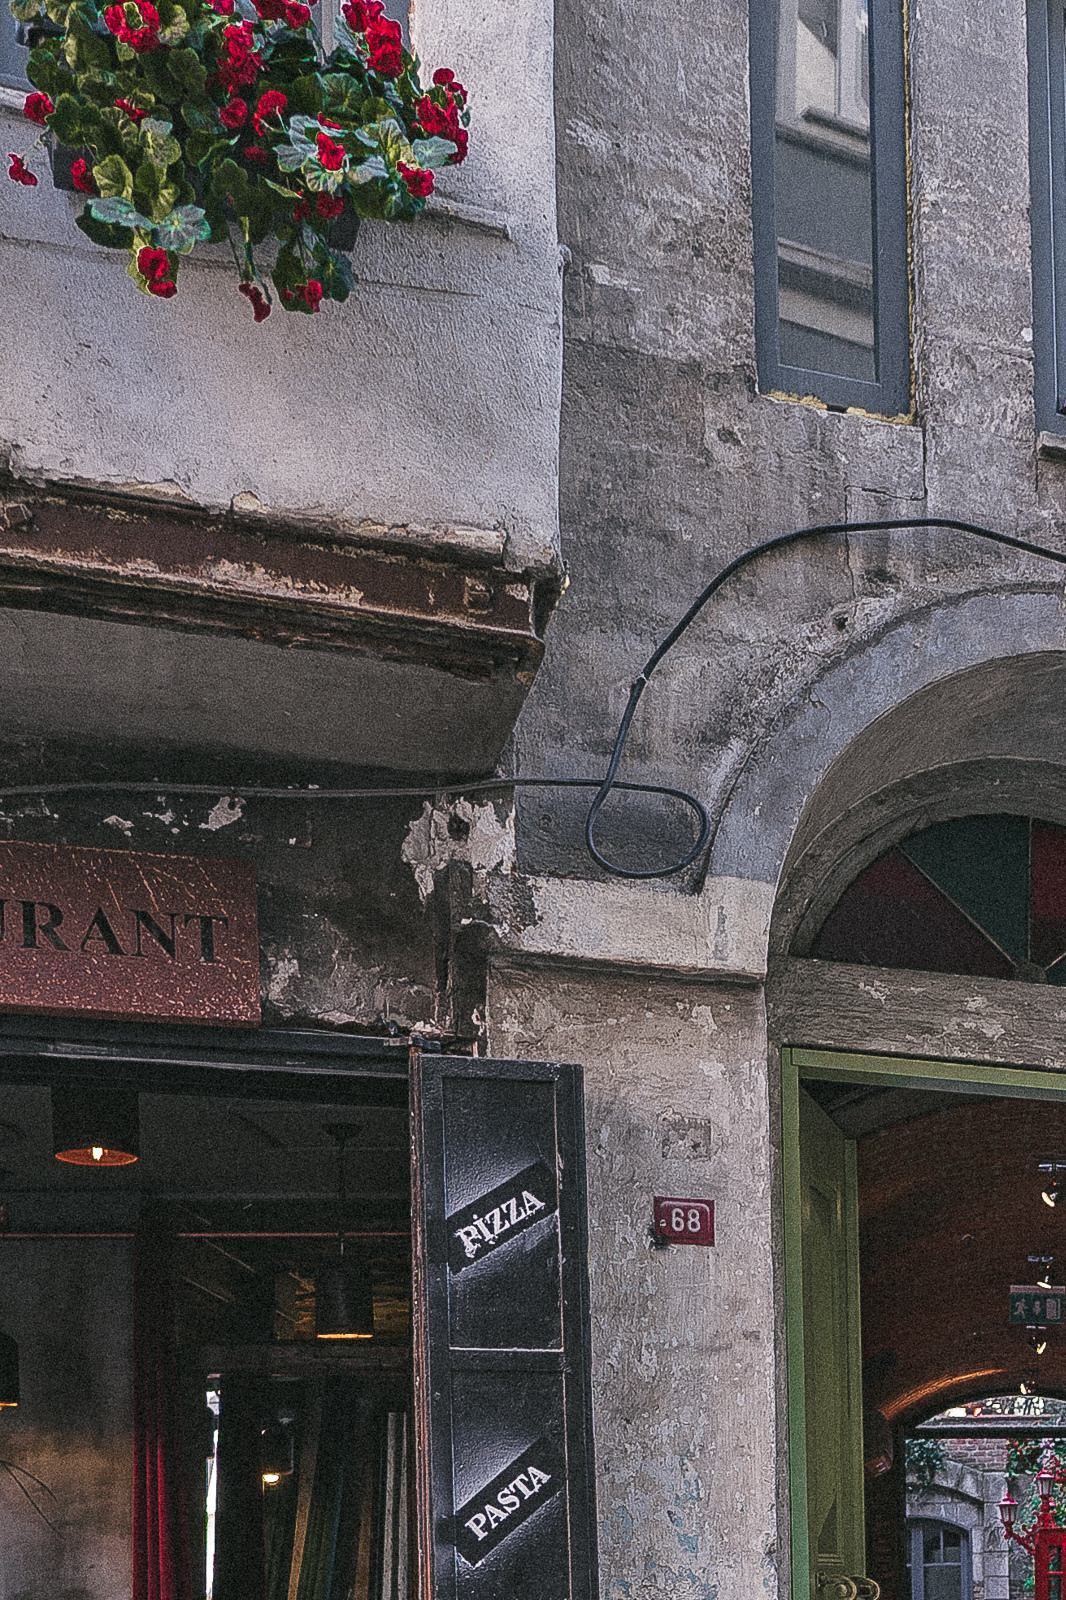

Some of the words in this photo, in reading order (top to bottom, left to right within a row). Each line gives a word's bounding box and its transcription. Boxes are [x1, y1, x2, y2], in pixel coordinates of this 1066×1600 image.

[0, 900, 229, 963] RANT
[670, 1208, 700, 1233] 68
[464, 1464, 552, 1541] PASTA
